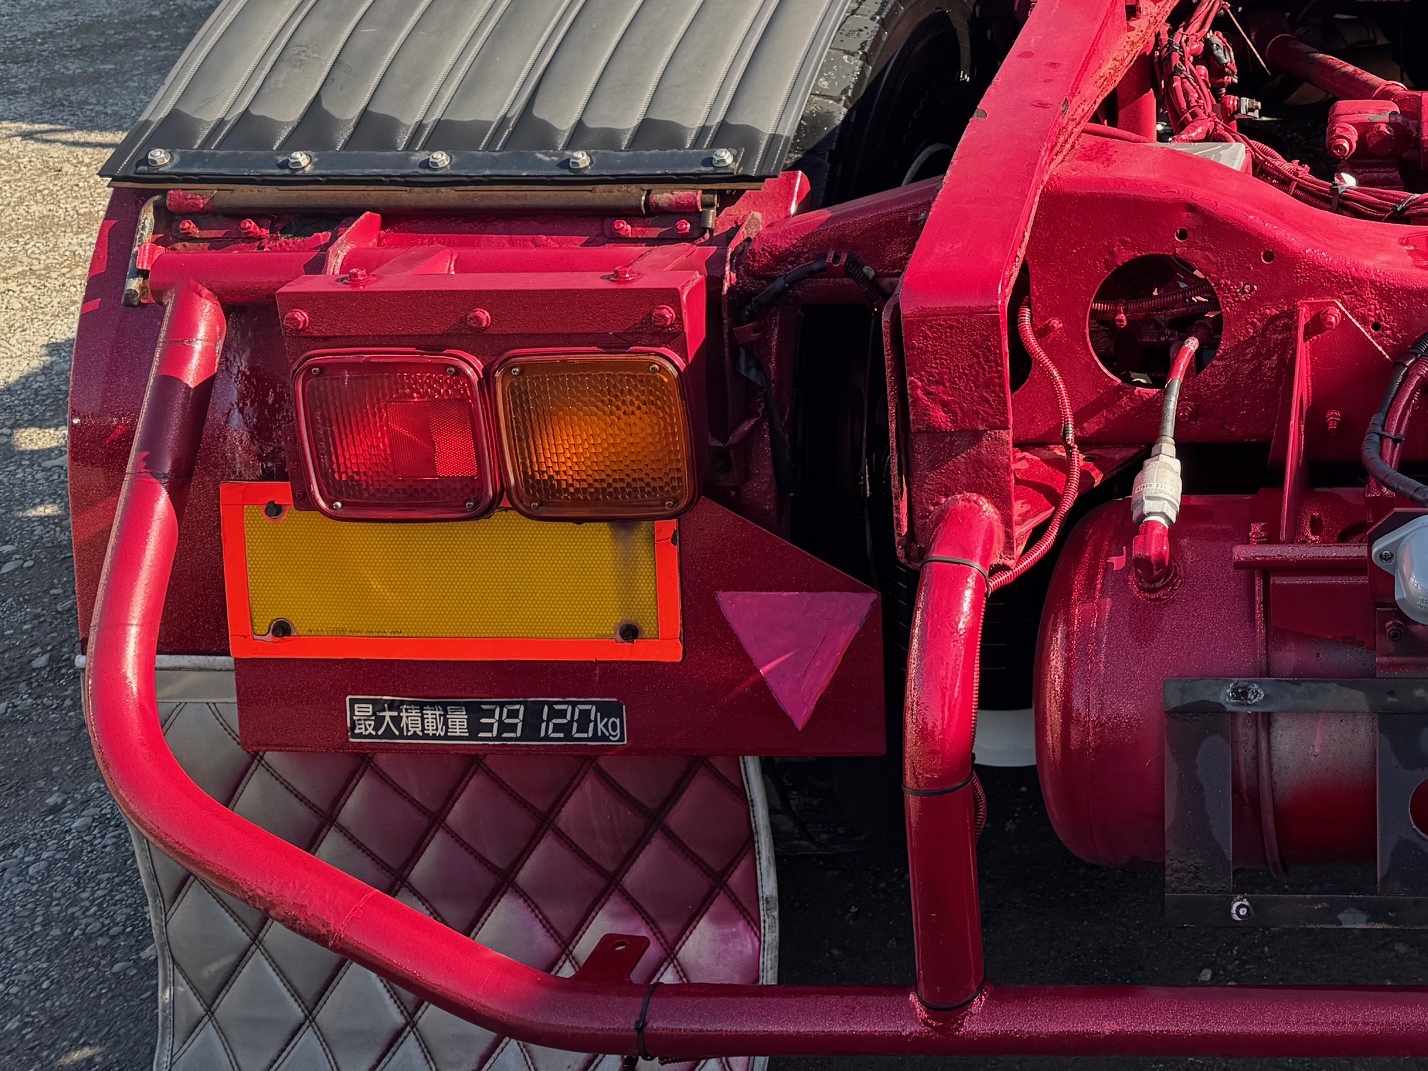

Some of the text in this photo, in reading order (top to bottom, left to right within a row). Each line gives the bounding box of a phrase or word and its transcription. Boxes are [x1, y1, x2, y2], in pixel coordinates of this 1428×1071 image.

[352, 703, 470, 737] 最大積載量
